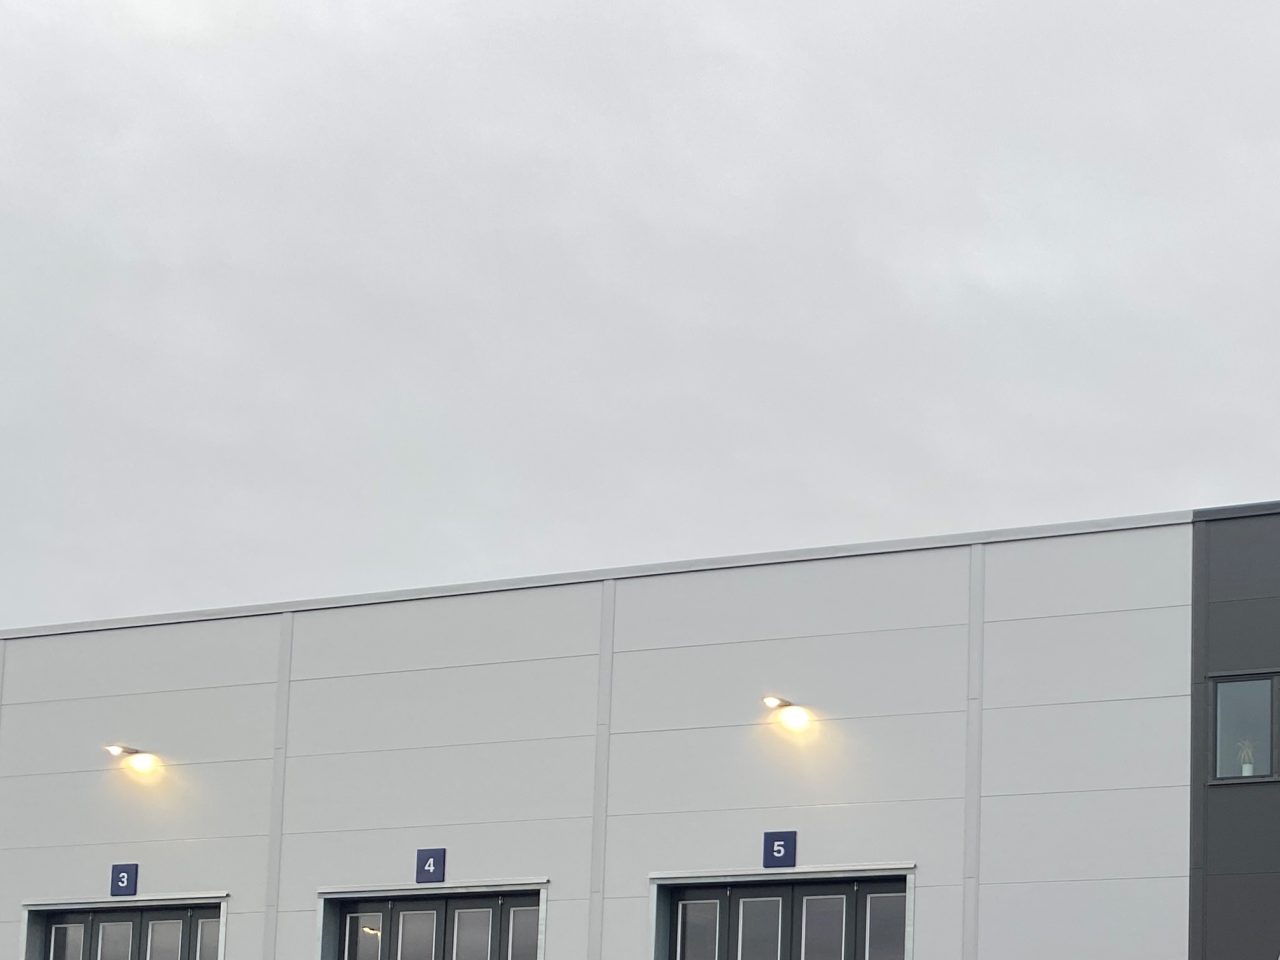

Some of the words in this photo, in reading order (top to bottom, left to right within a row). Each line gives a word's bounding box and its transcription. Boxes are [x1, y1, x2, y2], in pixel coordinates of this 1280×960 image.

[773, 841, 785, 857] 5
[424, 857, 435, 873] 4
[118, 872, 128, 887] 3
